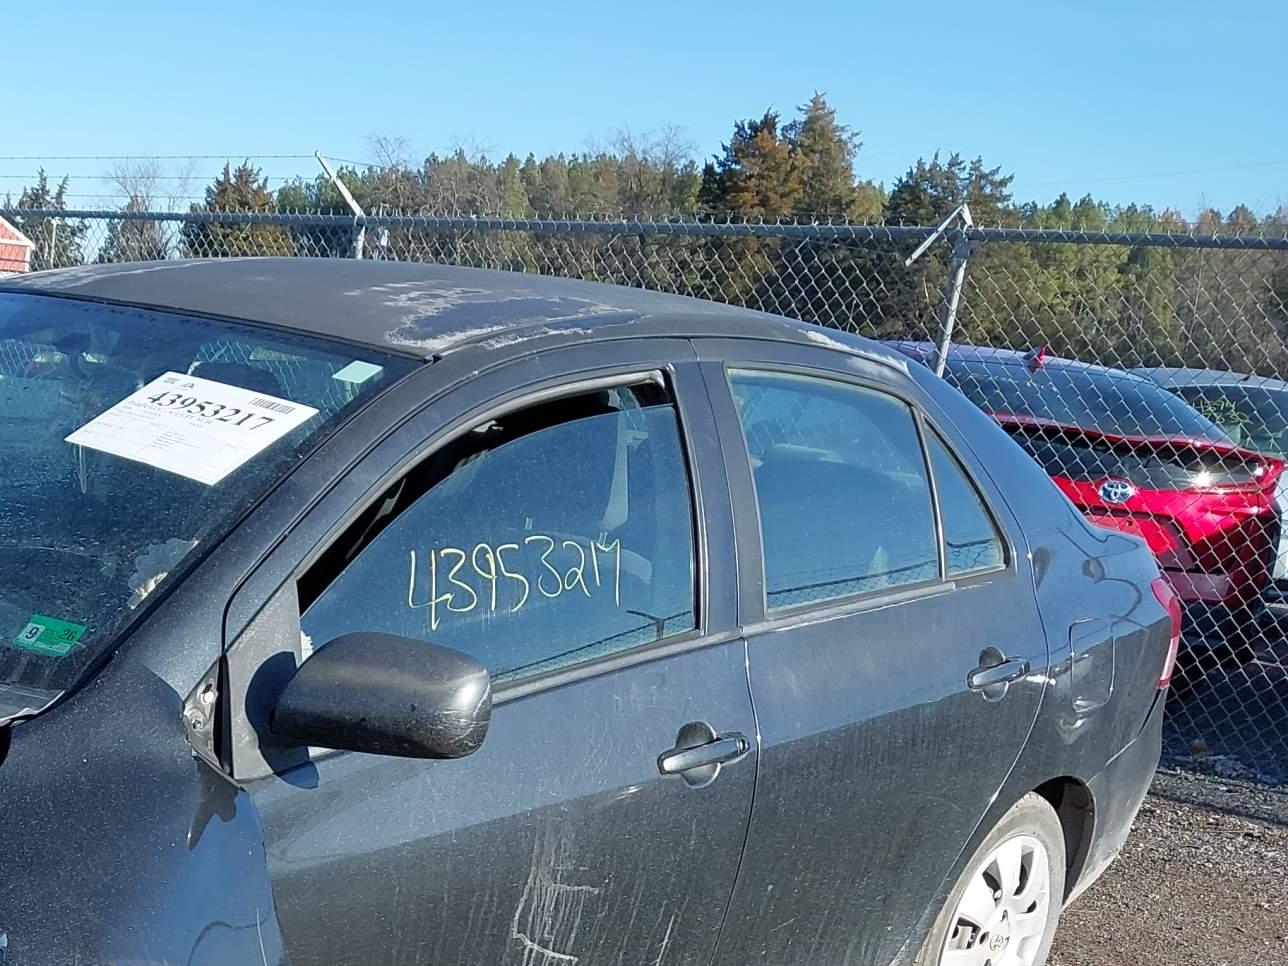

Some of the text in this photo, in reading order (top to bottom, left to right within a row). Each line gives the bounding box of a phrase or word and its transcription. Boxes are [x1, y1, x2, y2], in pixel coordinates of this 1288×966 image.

[147, 391, 275, 430] 43953217
[408, 535, 622, 631] 43953217
[25, 626, 39, 640] 9
